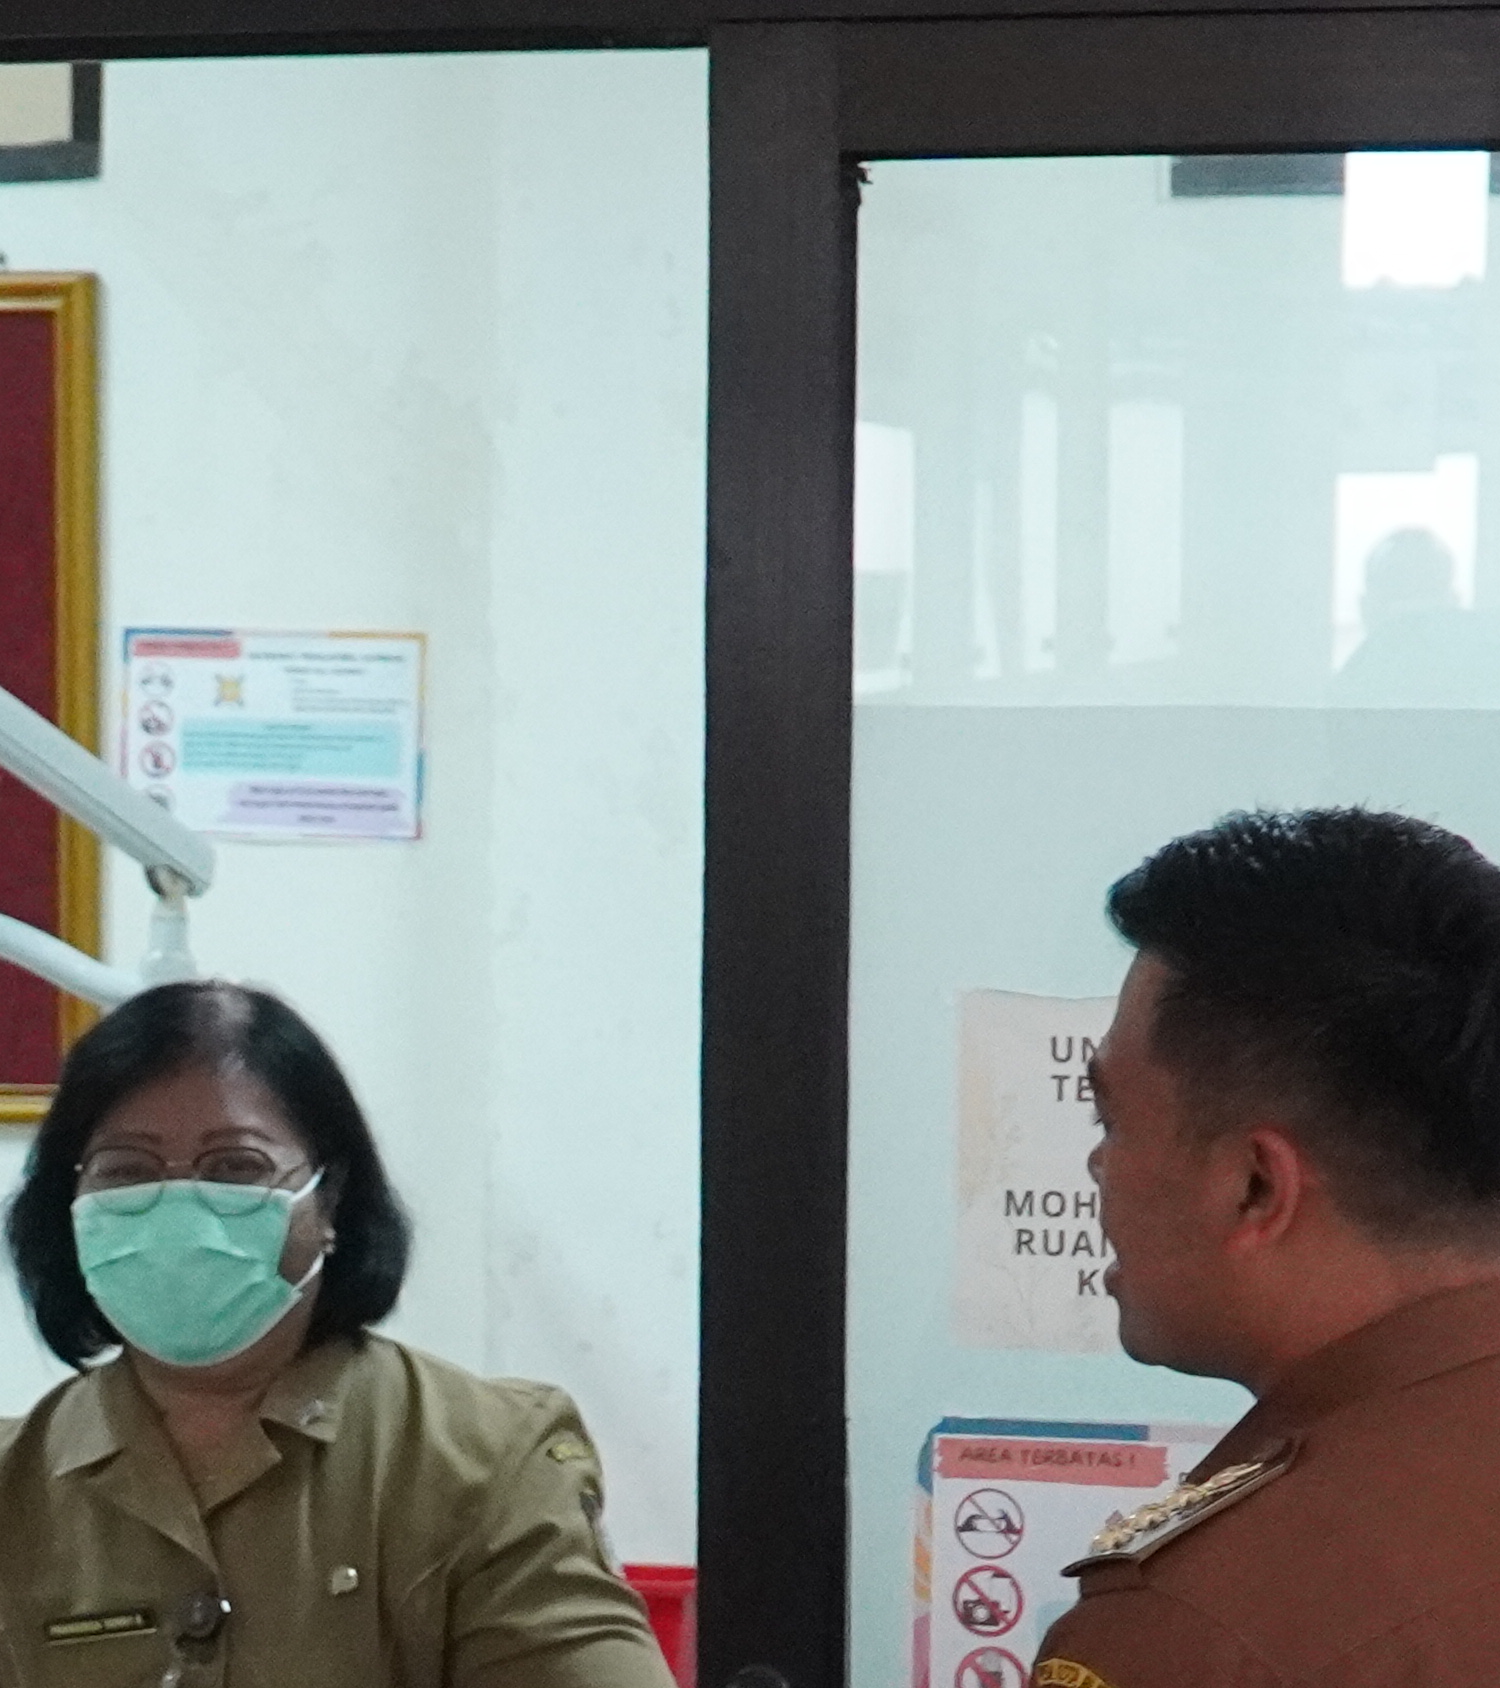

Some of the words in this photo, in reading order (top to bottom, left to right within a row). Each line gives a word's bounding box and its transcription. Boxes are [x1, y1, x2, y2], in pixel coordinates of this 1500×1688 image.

[1050, 1035, 1102, 1064] UN
[1050, 1074, 1096, 1102] TE
[1004, 1189, 1099, 1218] MOH
[1015, 1228, 1115, 1258] RUA
[1077, 1269, 1102, 1297] K
[958, 1447, 1012, 1464] AREA
[1020, 1448, 1123, 1468] TERBATAS
